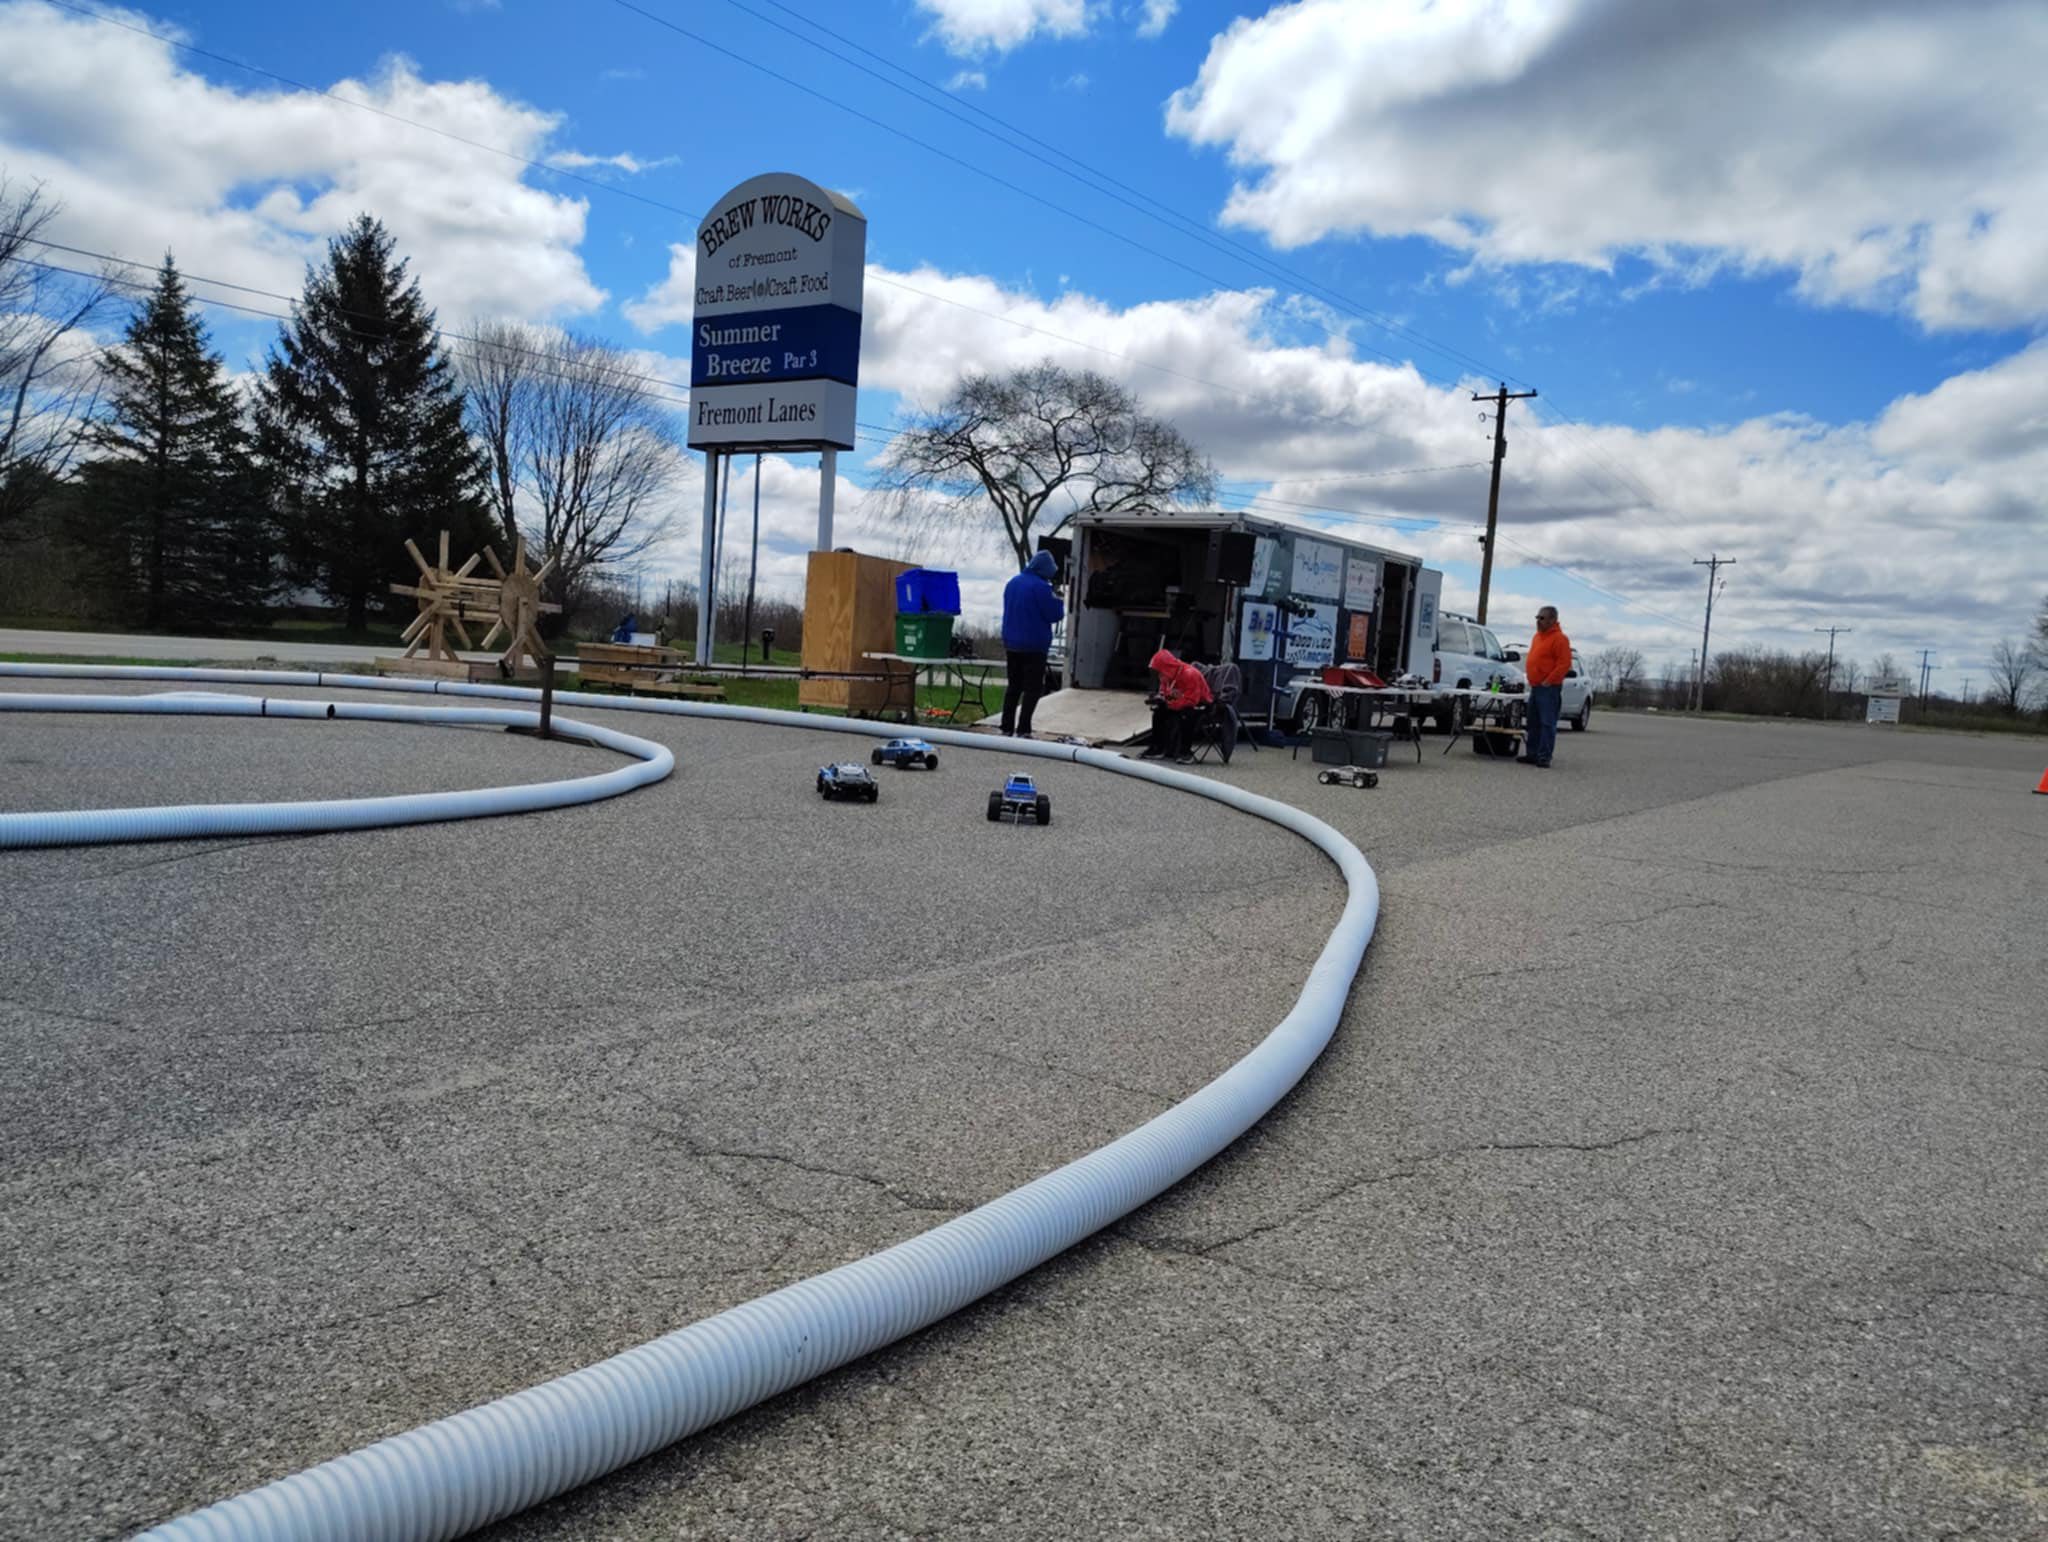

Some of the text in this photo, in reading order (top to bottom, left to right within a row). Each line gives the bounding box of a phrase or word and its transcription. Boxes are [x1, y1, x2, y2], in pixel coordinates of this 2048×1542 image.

[700, 194, 831, 258] BREW WORKS
[728, 248, 798, 269] of Fremont
[696, 272, 829, 305] Craft Beer Craft Food
[699, 323, 781, 348] Summer
[707, 350, 817, 376] Breeze Par 3
[697, 397, 816, 426] Fremont Lanes
